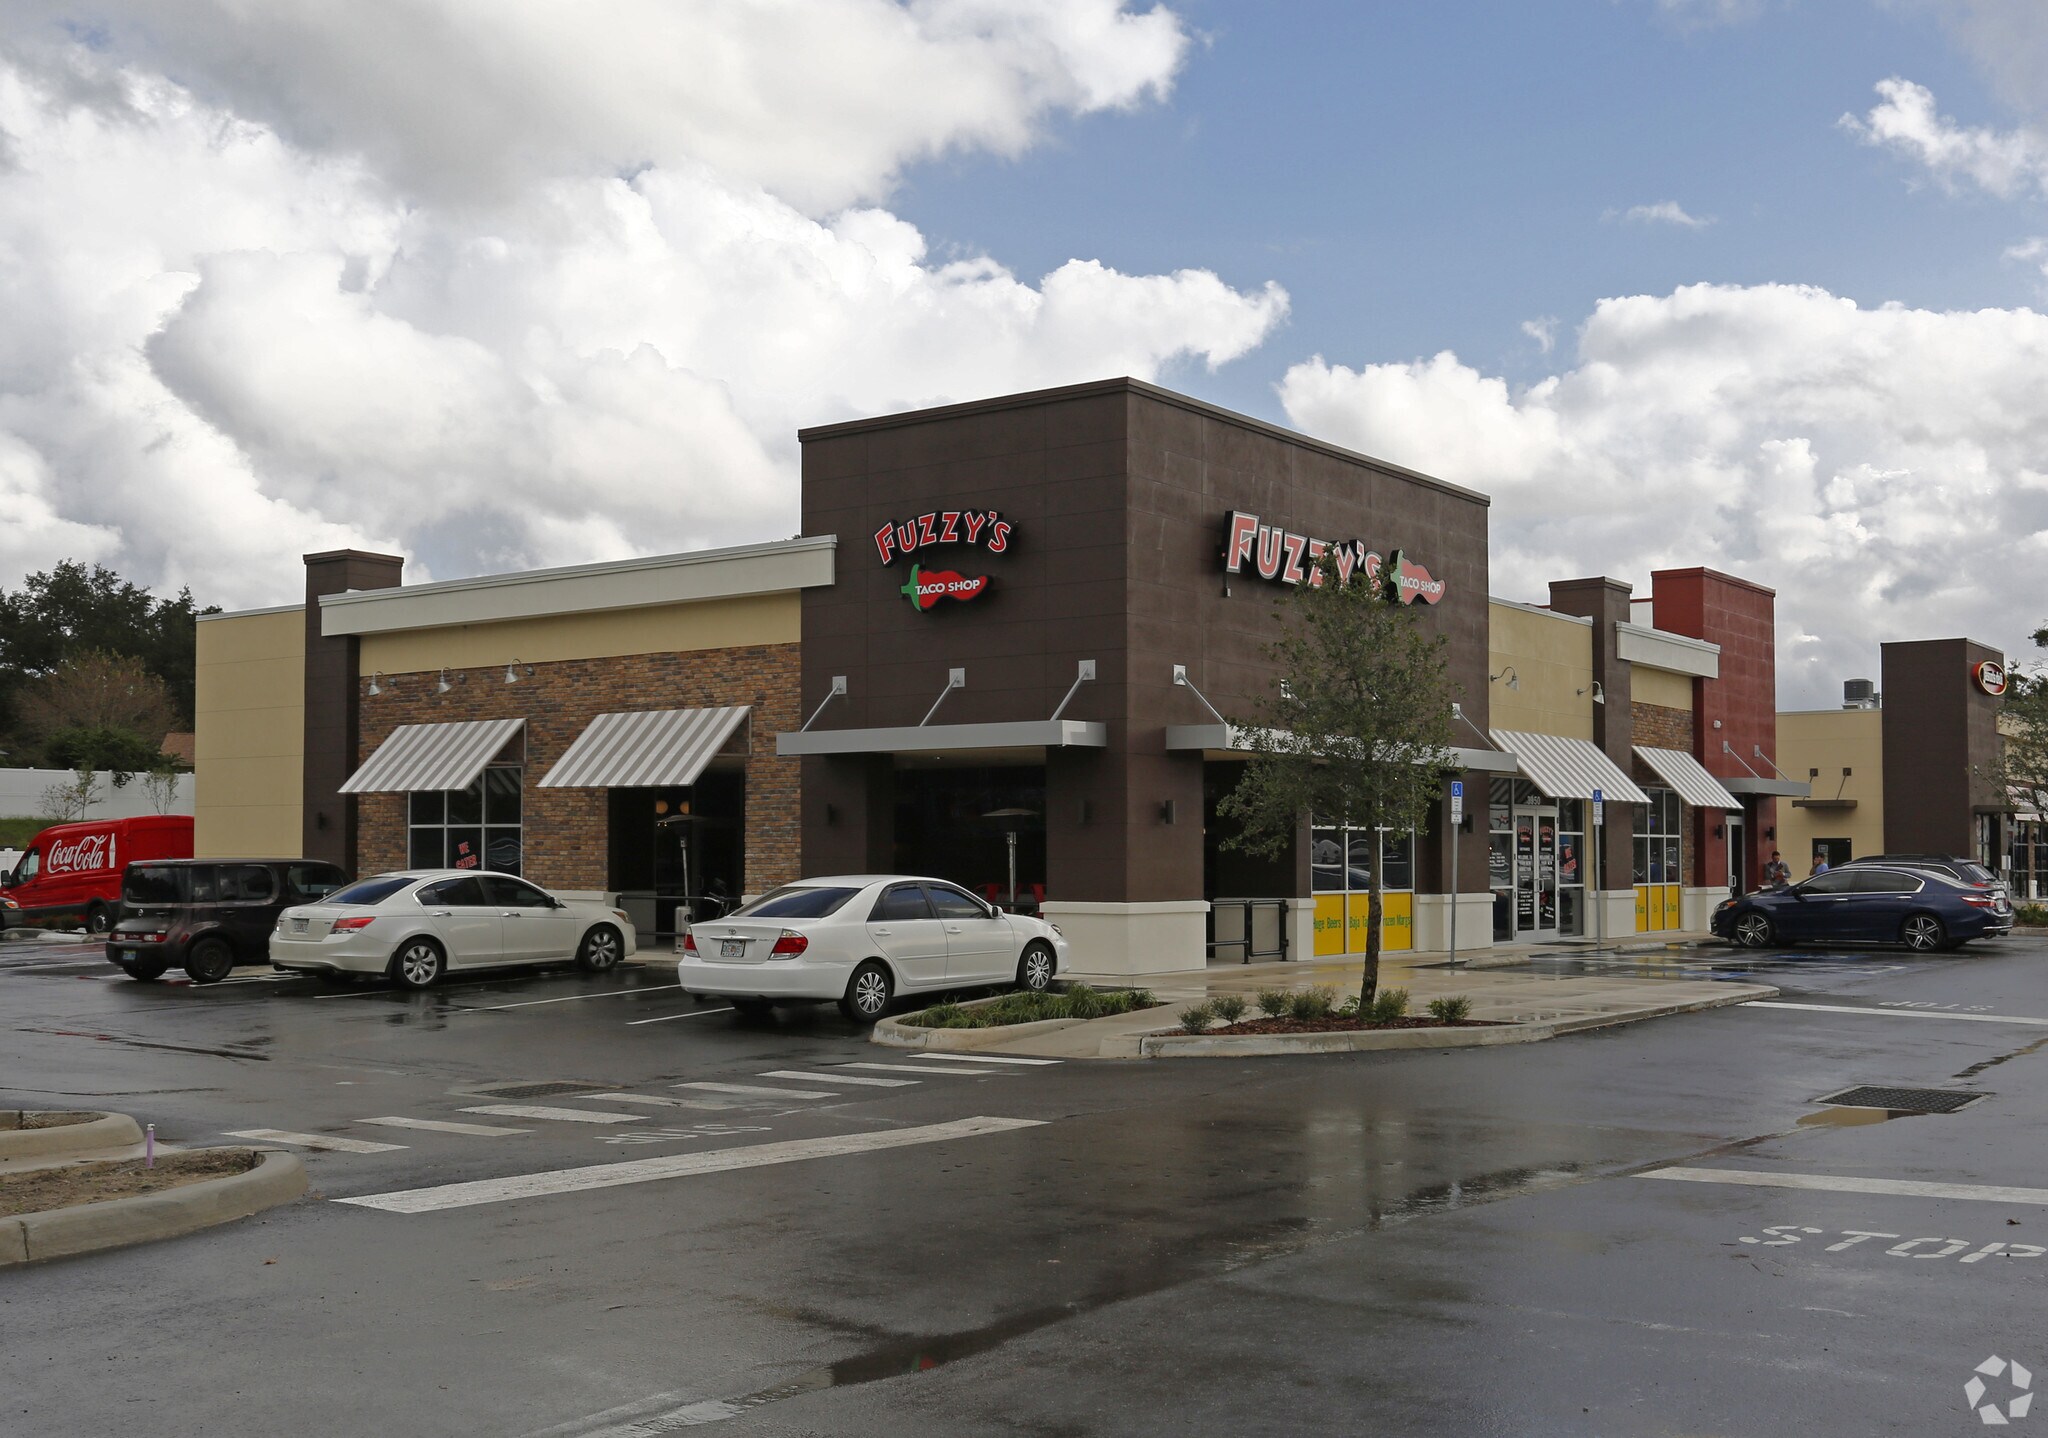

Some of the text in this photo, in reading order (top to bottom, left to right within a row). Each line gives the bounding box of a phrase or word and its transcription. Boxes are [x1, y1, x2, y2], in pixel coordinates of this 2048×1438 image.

[874, 510, 1012, 565] FUZZY'S
[915, 580, 981, 595] TACO SHOP
[1399, 575, 1441, 594] TACO SHOP
[456, 854, 478, 869] CATER
[1738, 1225, 2047, 1263] STOP
